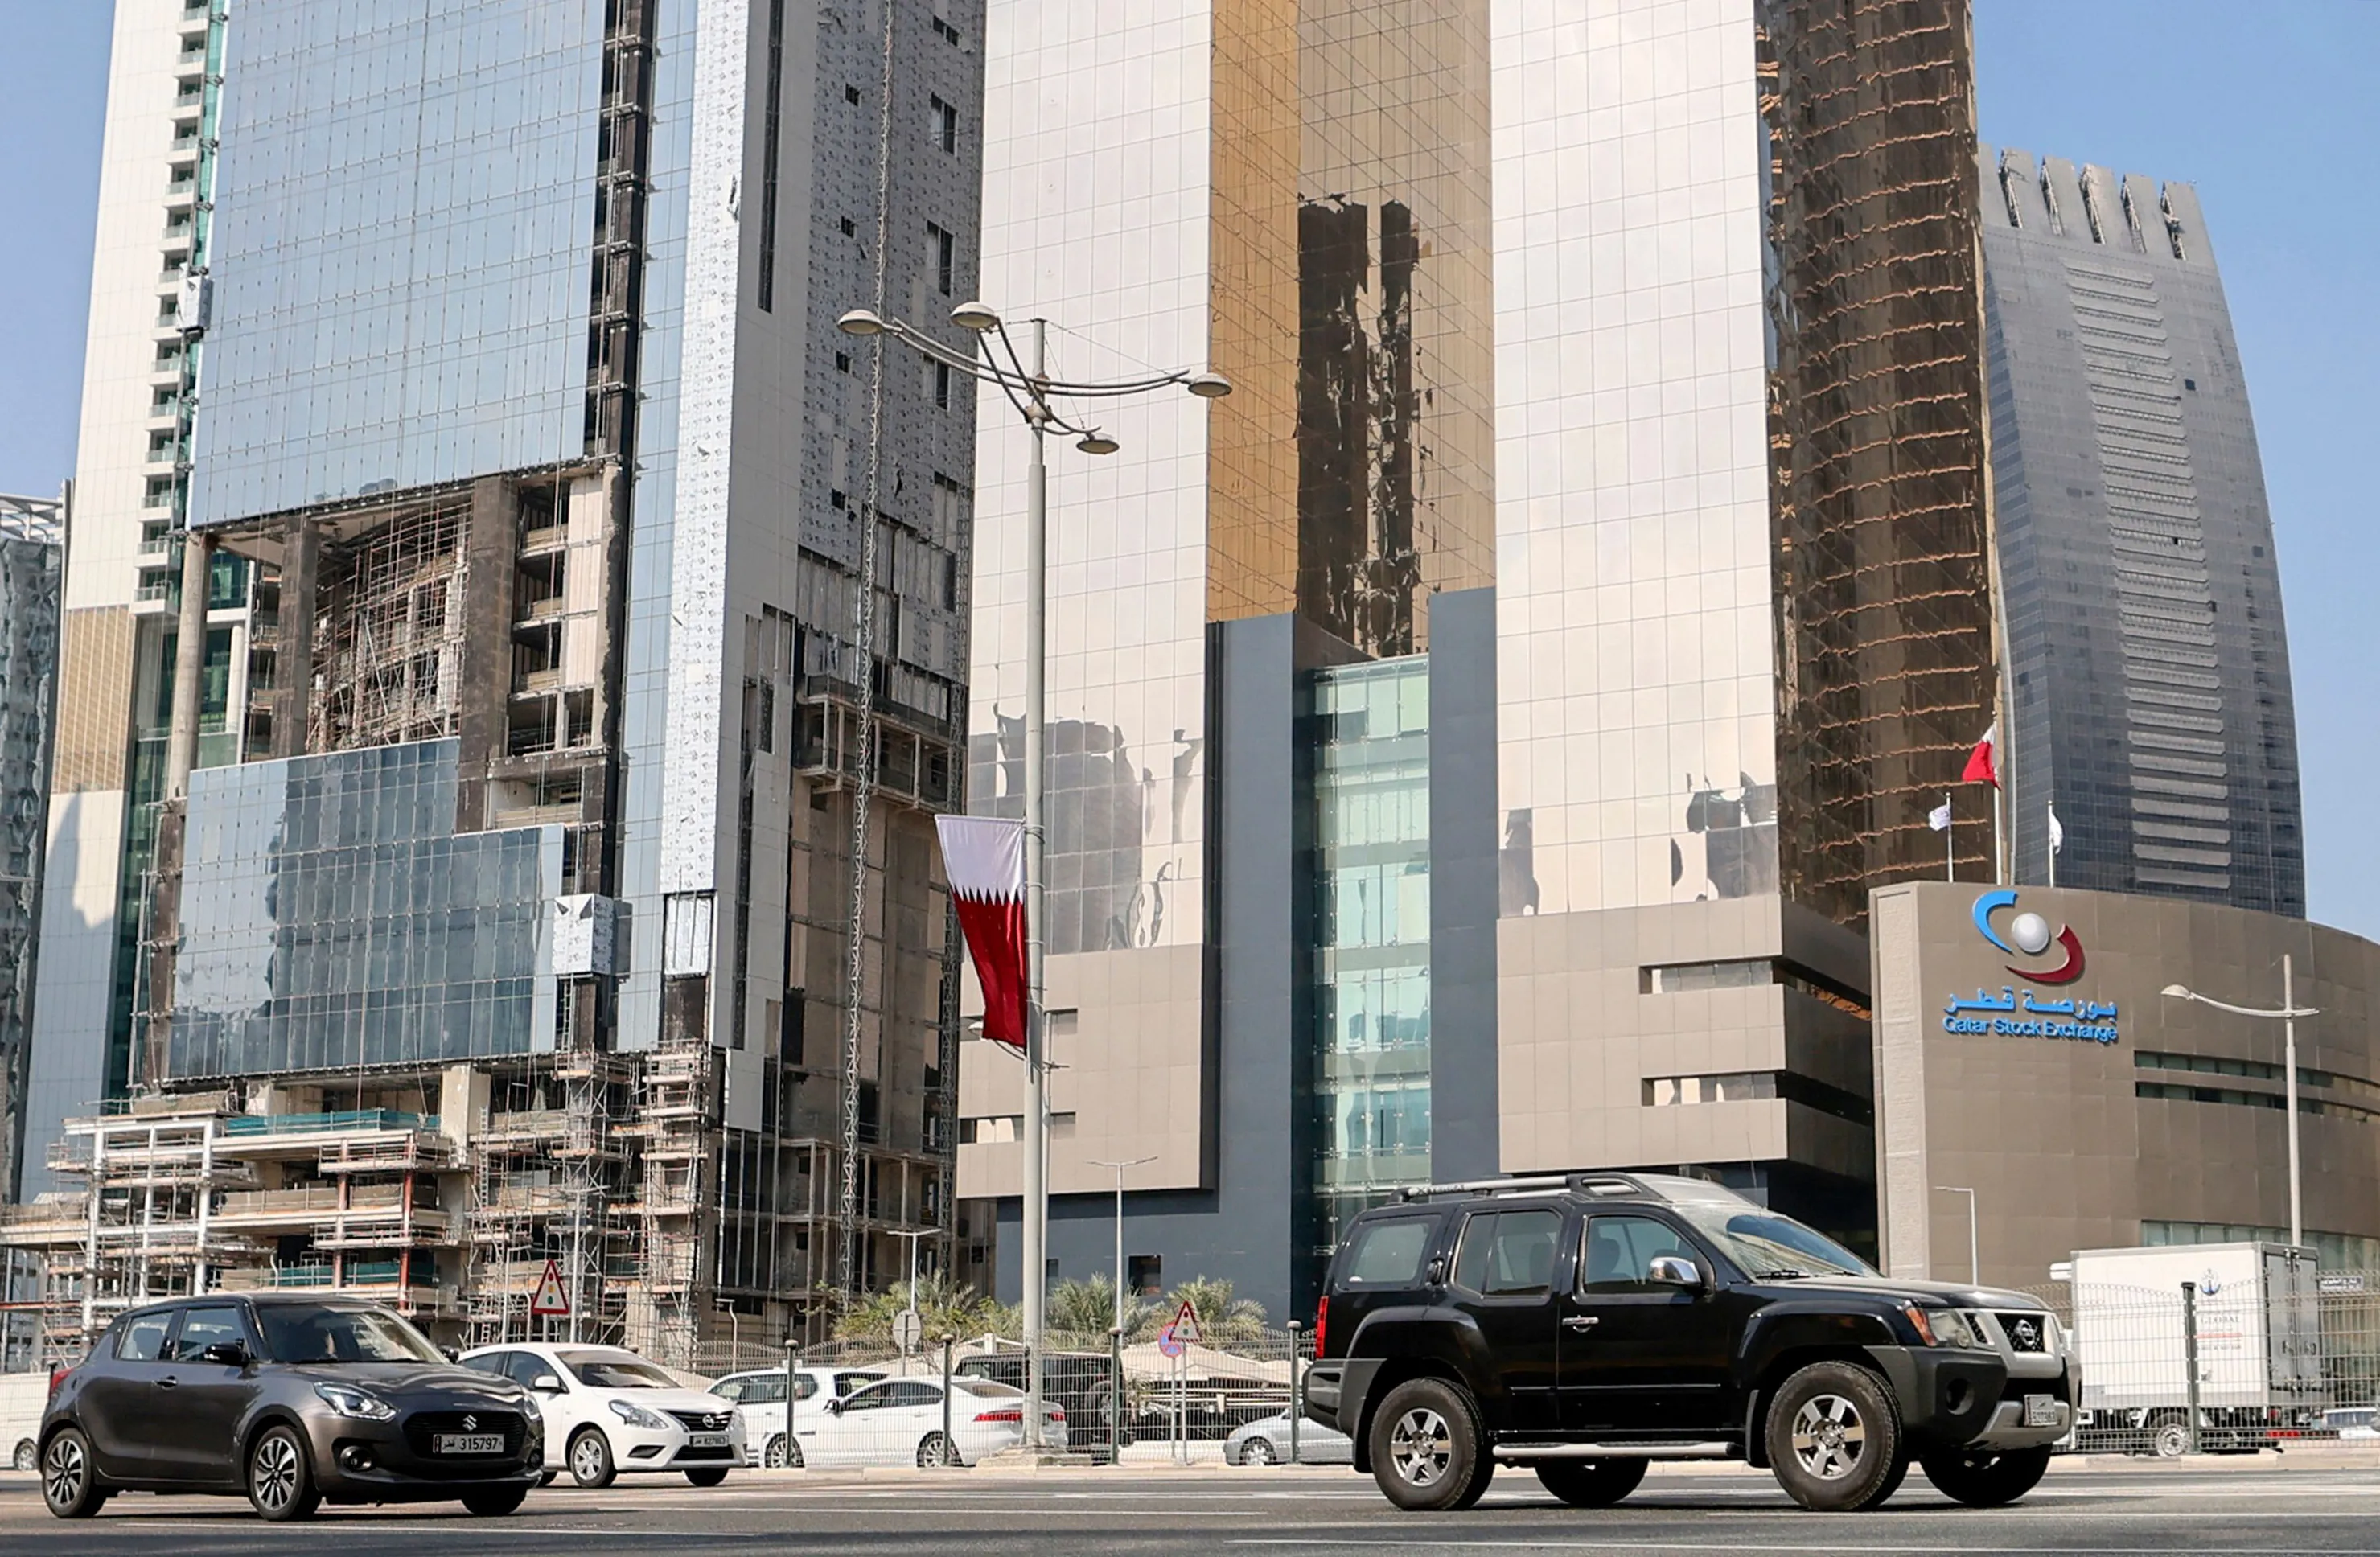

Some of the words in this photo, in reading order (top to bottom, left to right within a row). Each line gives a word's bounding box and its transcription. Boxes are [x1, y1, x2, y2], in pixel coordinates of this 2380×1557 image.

[1943, 985, 2016, 1014] قطر
[2021, 989, 2118, 1024] بورصة
[1942, 1016, 1991, 1035] Qatar
[1992, 1017, 2041, 1037] Stock
[2043, 1020, 2119, 1043] Exchange
[459, 1437, 499, 1451] 315797
